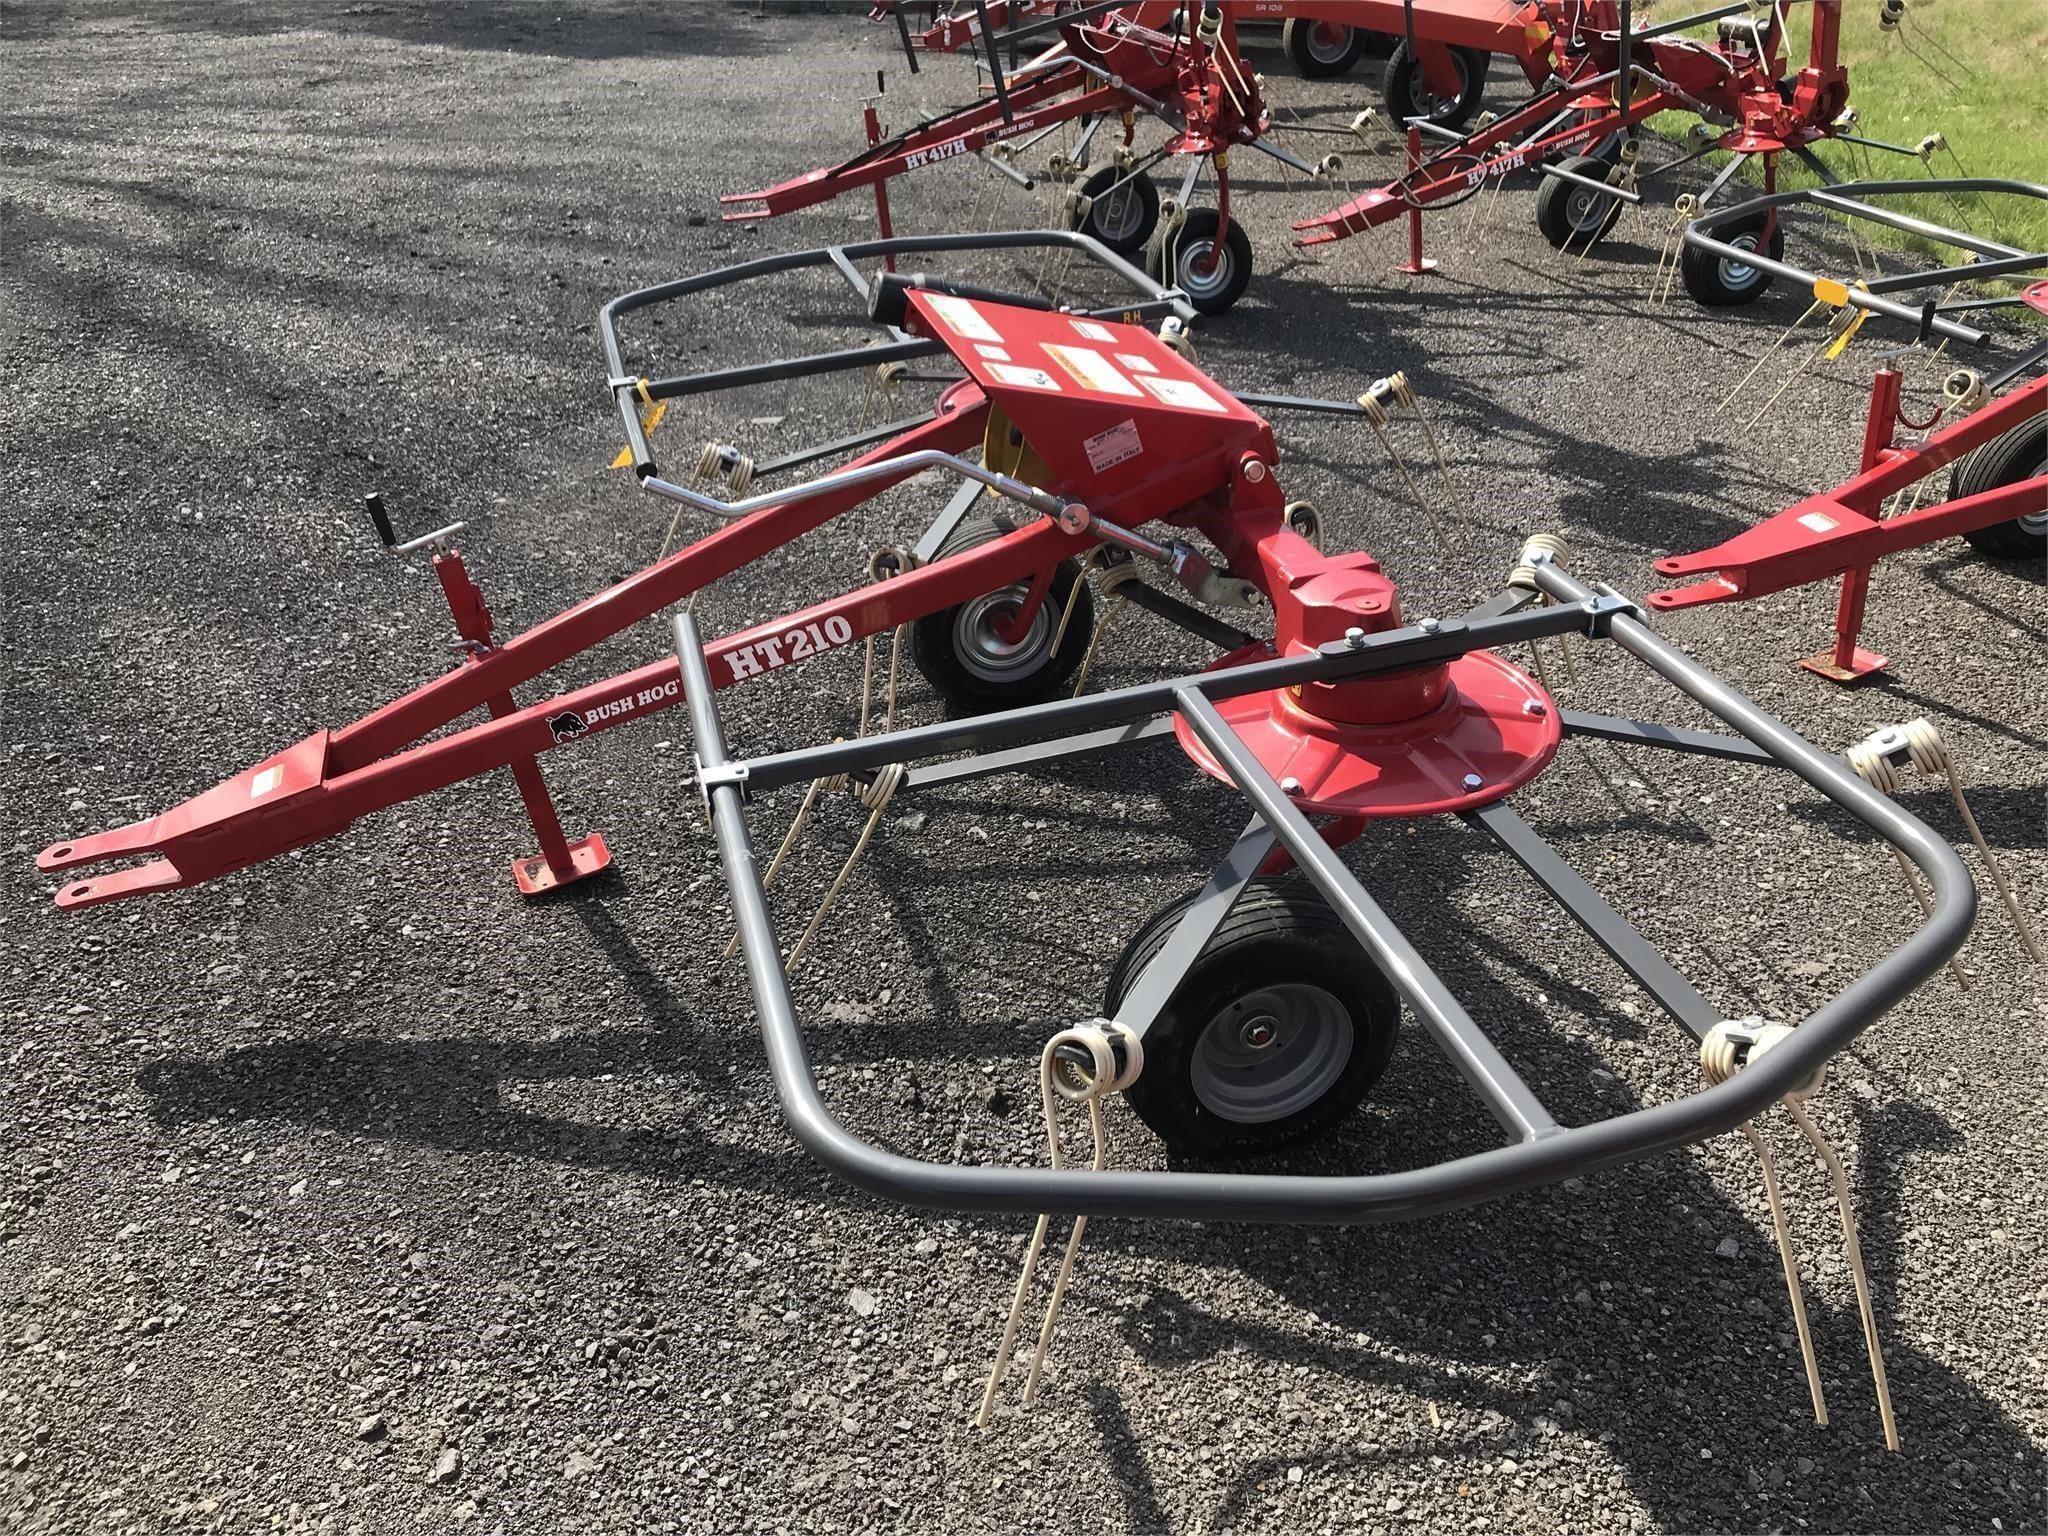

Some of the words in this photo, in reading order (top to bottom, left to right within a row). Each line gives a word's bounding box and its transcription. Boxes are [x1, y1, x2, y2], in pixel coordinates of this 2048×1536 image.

[998, 123, 1018, 137] BUSH
[1018, 119, 1035, 131] HOG
[1096, 458, 1113, 471] MADE
[1123, 446, 1140, 458] ITALY
[584, 694, 636, 725] BUSH
[636, 680, 679, 706] HOG
